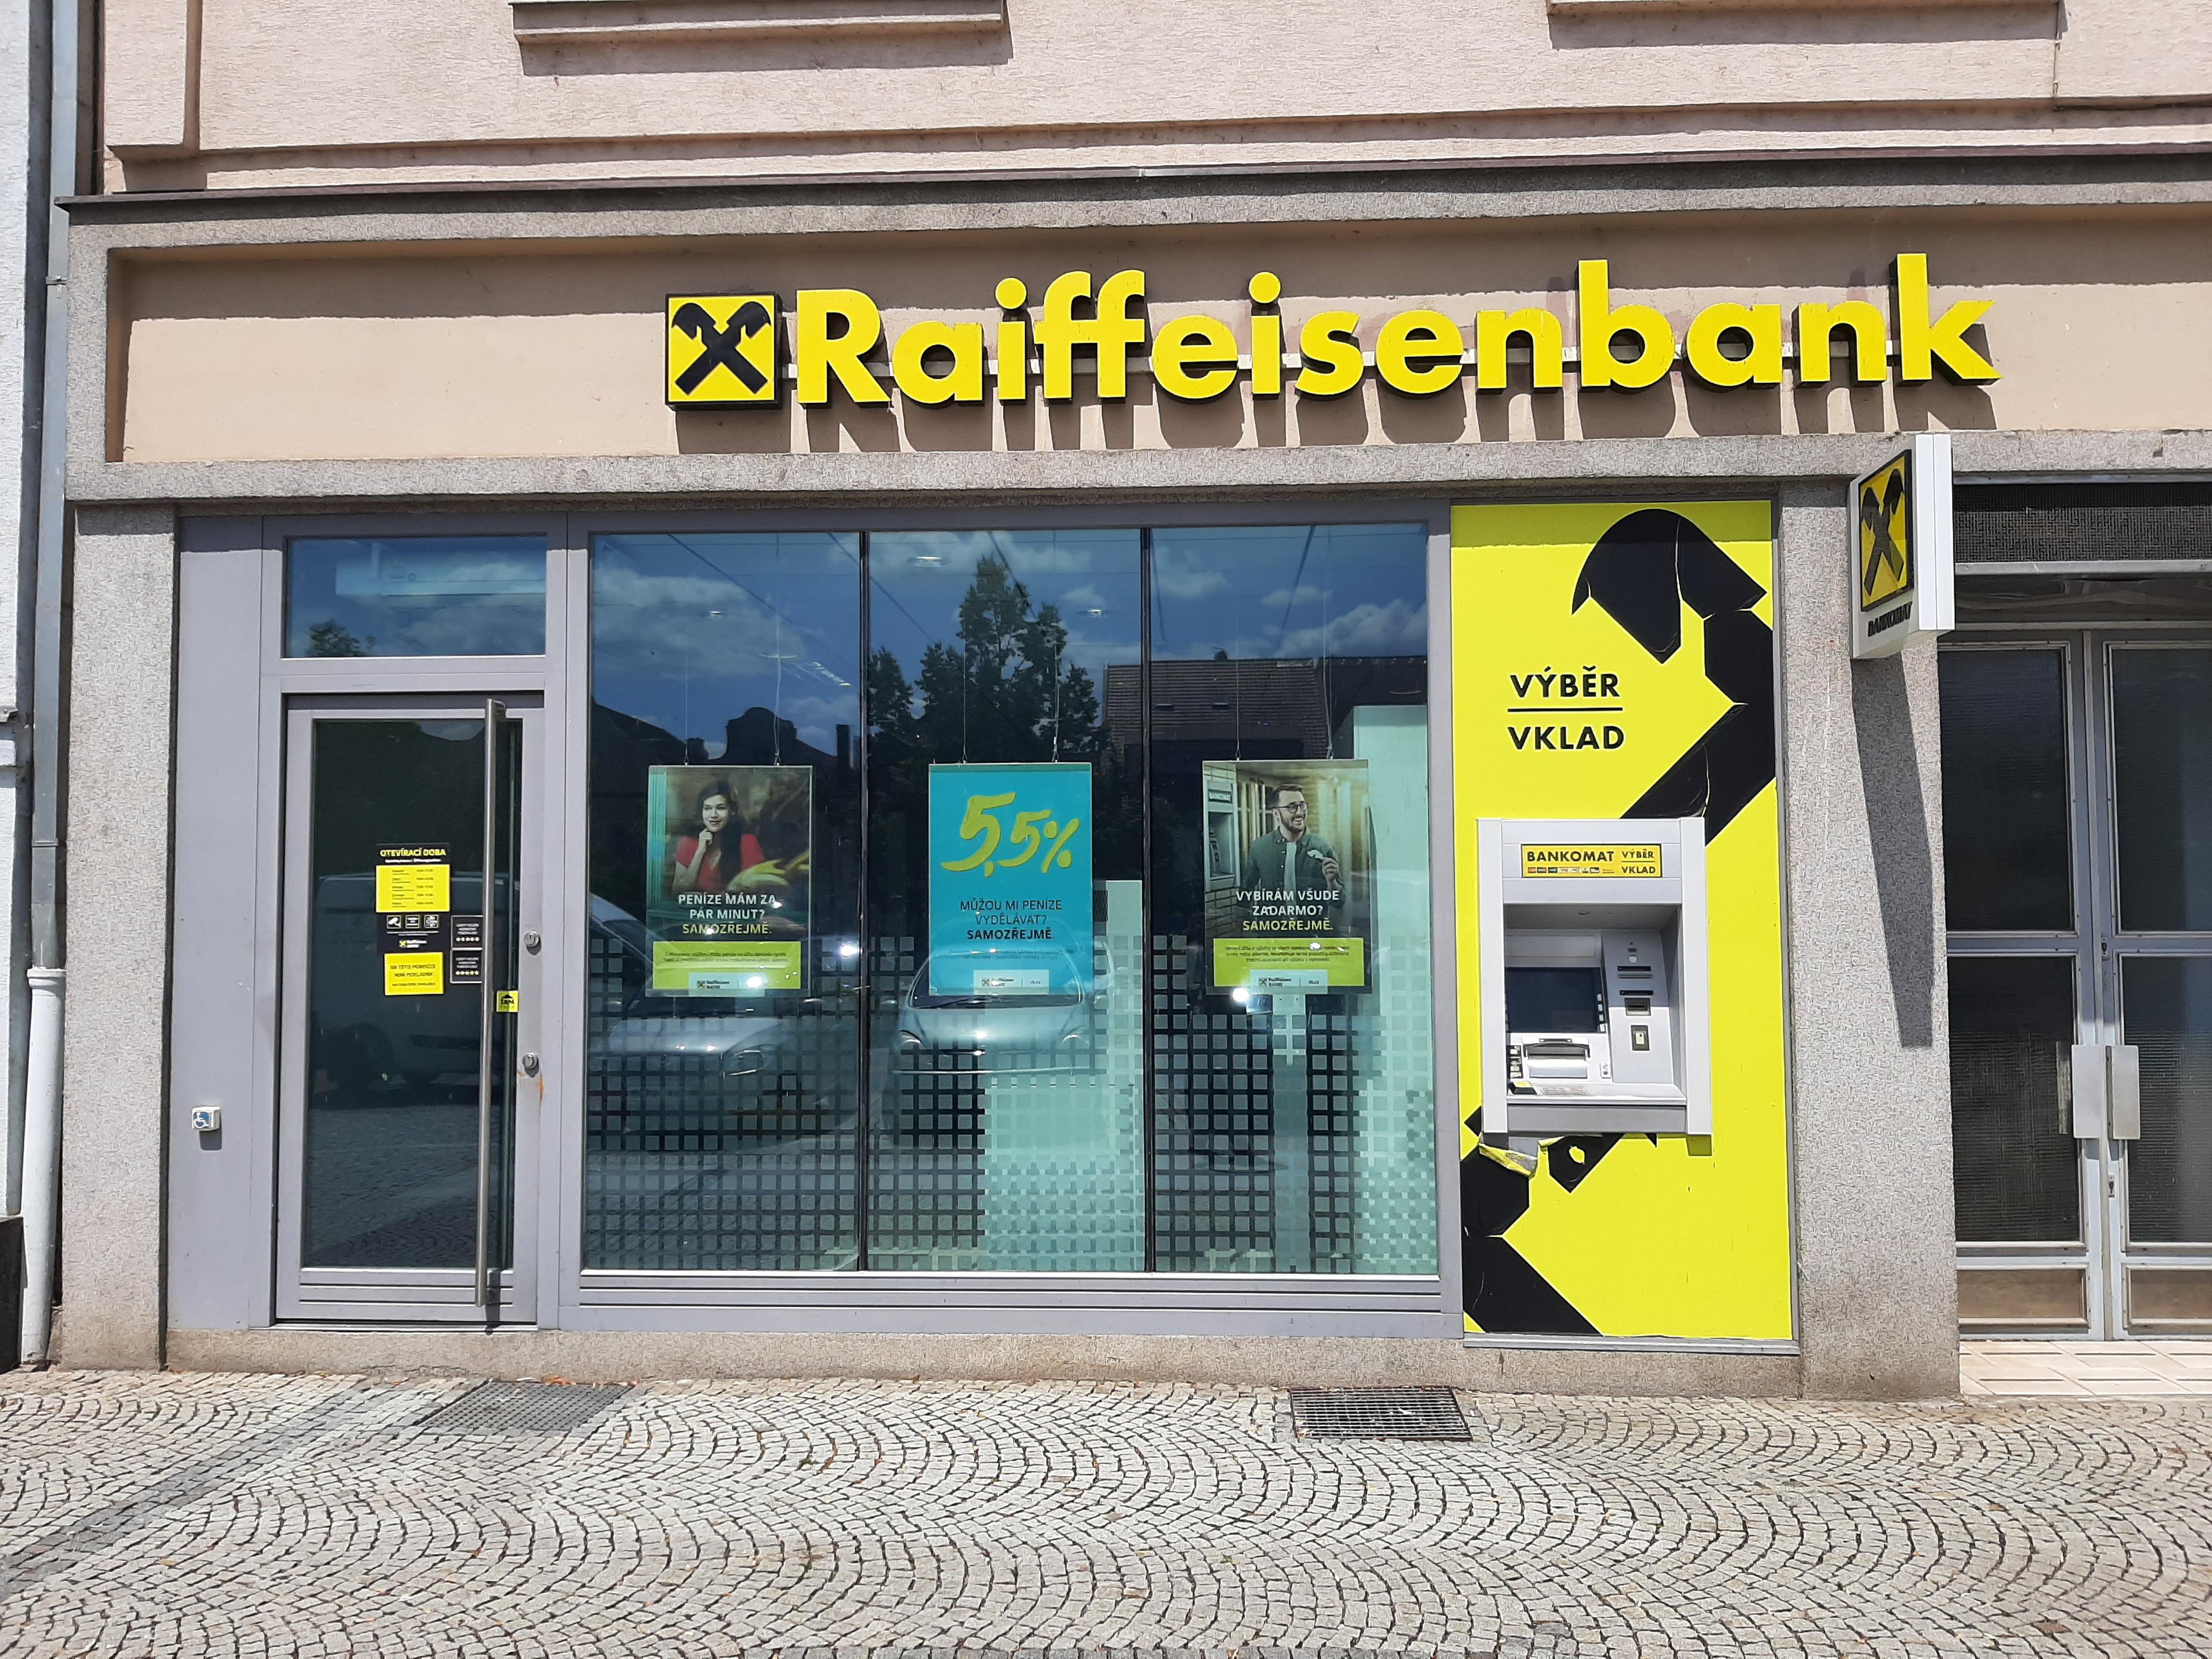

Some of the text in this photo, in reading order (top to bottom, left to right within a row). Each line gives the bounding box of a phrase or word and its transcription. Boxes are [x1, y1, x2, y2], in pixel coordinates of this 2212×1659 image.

[796, 253, 2001, 406] Raiffeisenbank
[1867, 601, 1912, 637] BANKOMAT
[1510, 665, 1620, 698] VÝBĚR
[1507, 726, 1624, 750] VKLAD
[1527, 848, 1654, 862] BANKOMAT VÝBĚR
[679, 892, 776, 905] PENÍZE MÁM ZA
[1236, 887, 1339, 901] VYBÍRÁM VŠUDE
[961, 897, 1062, 910] MŮŽOU MI PENÍZE
[1253, 905, 1323, 916] ZADARMO?
[717, 909, 765, 920] MINUT?
[975, 912, 1047, 925] VYDĚLÁVAT?
